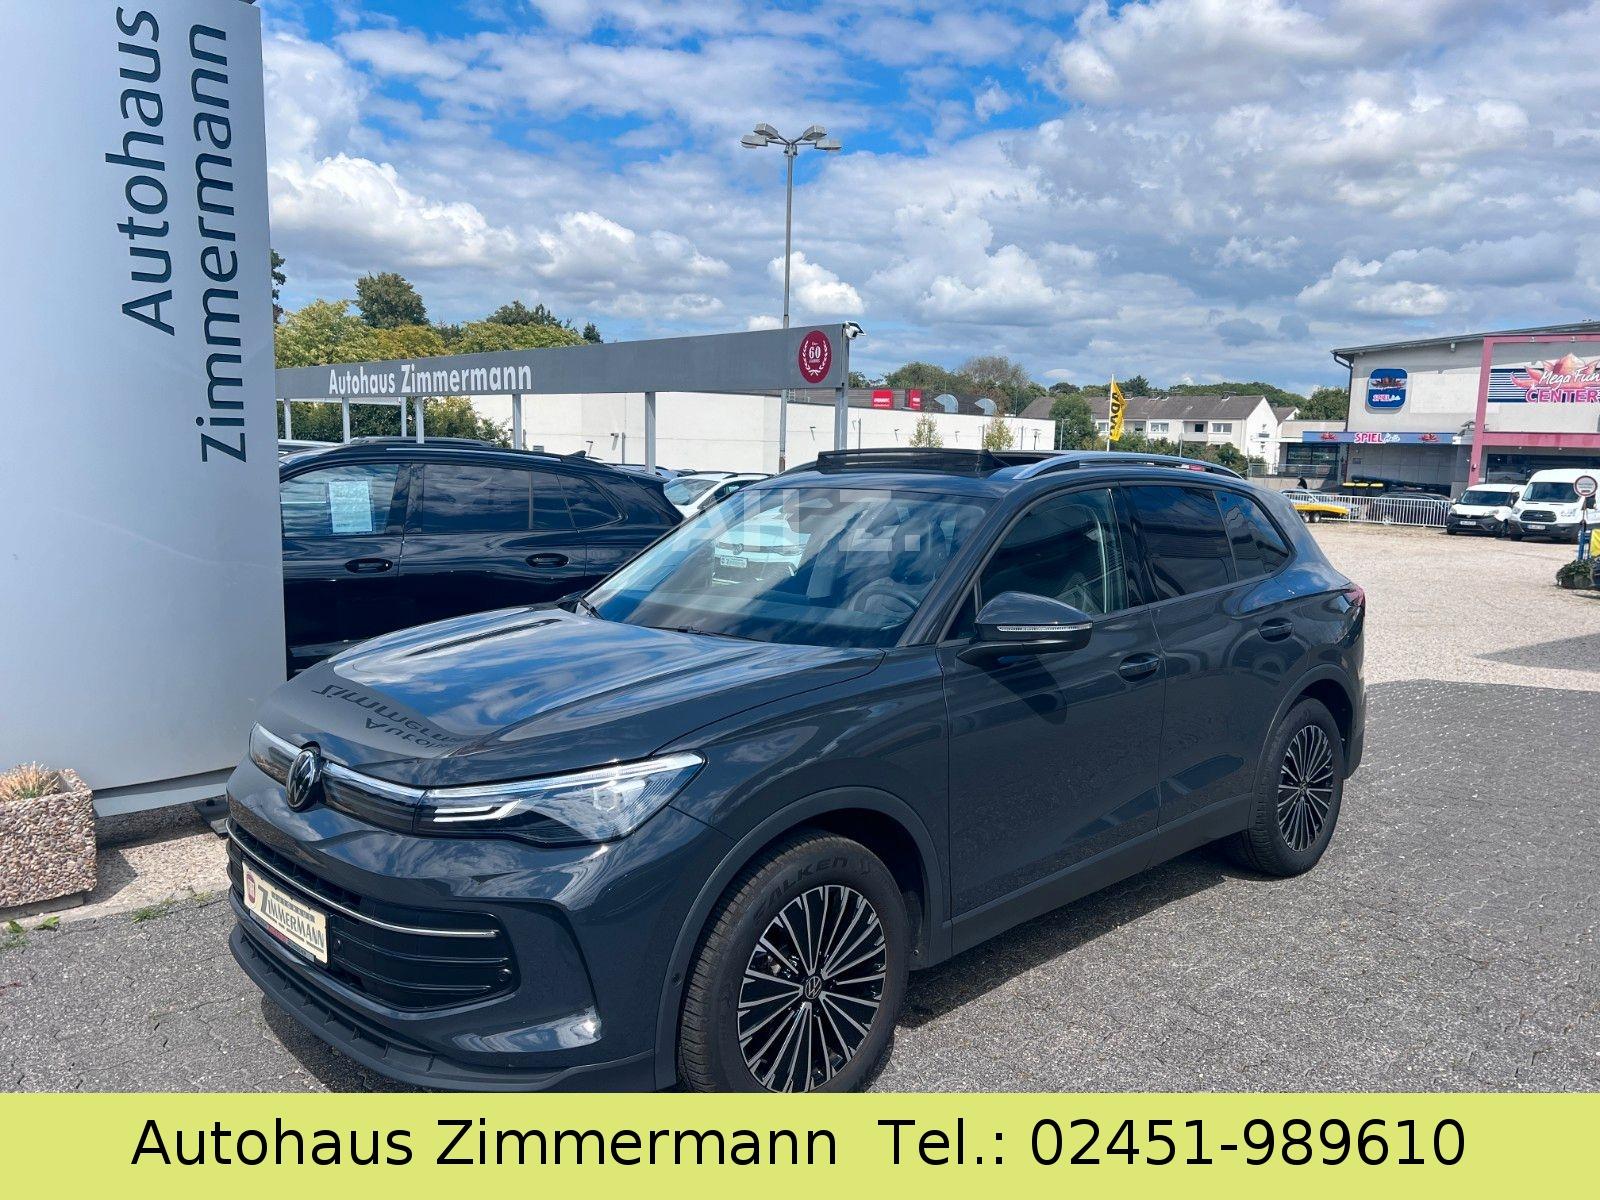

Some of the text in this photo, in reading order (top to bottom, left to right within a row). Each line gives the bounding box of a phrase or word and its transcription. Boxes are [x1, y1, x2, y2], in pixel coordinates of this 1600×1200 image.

[105, 6, 176, 337] Autohaus
[189, 23, 247, 463] Zimmermann
[808, 346, 822, 360] 60
[328, 363, 532, 395] Autohaus Zimmermann
[1538, 366, 1600, 391] Mega Fun
[1525, 387, 1599, 403] CENTER
[1354, 432, 1384, 444] SPIEL
[257, 885, 325, 949] ZIMMERMANN
